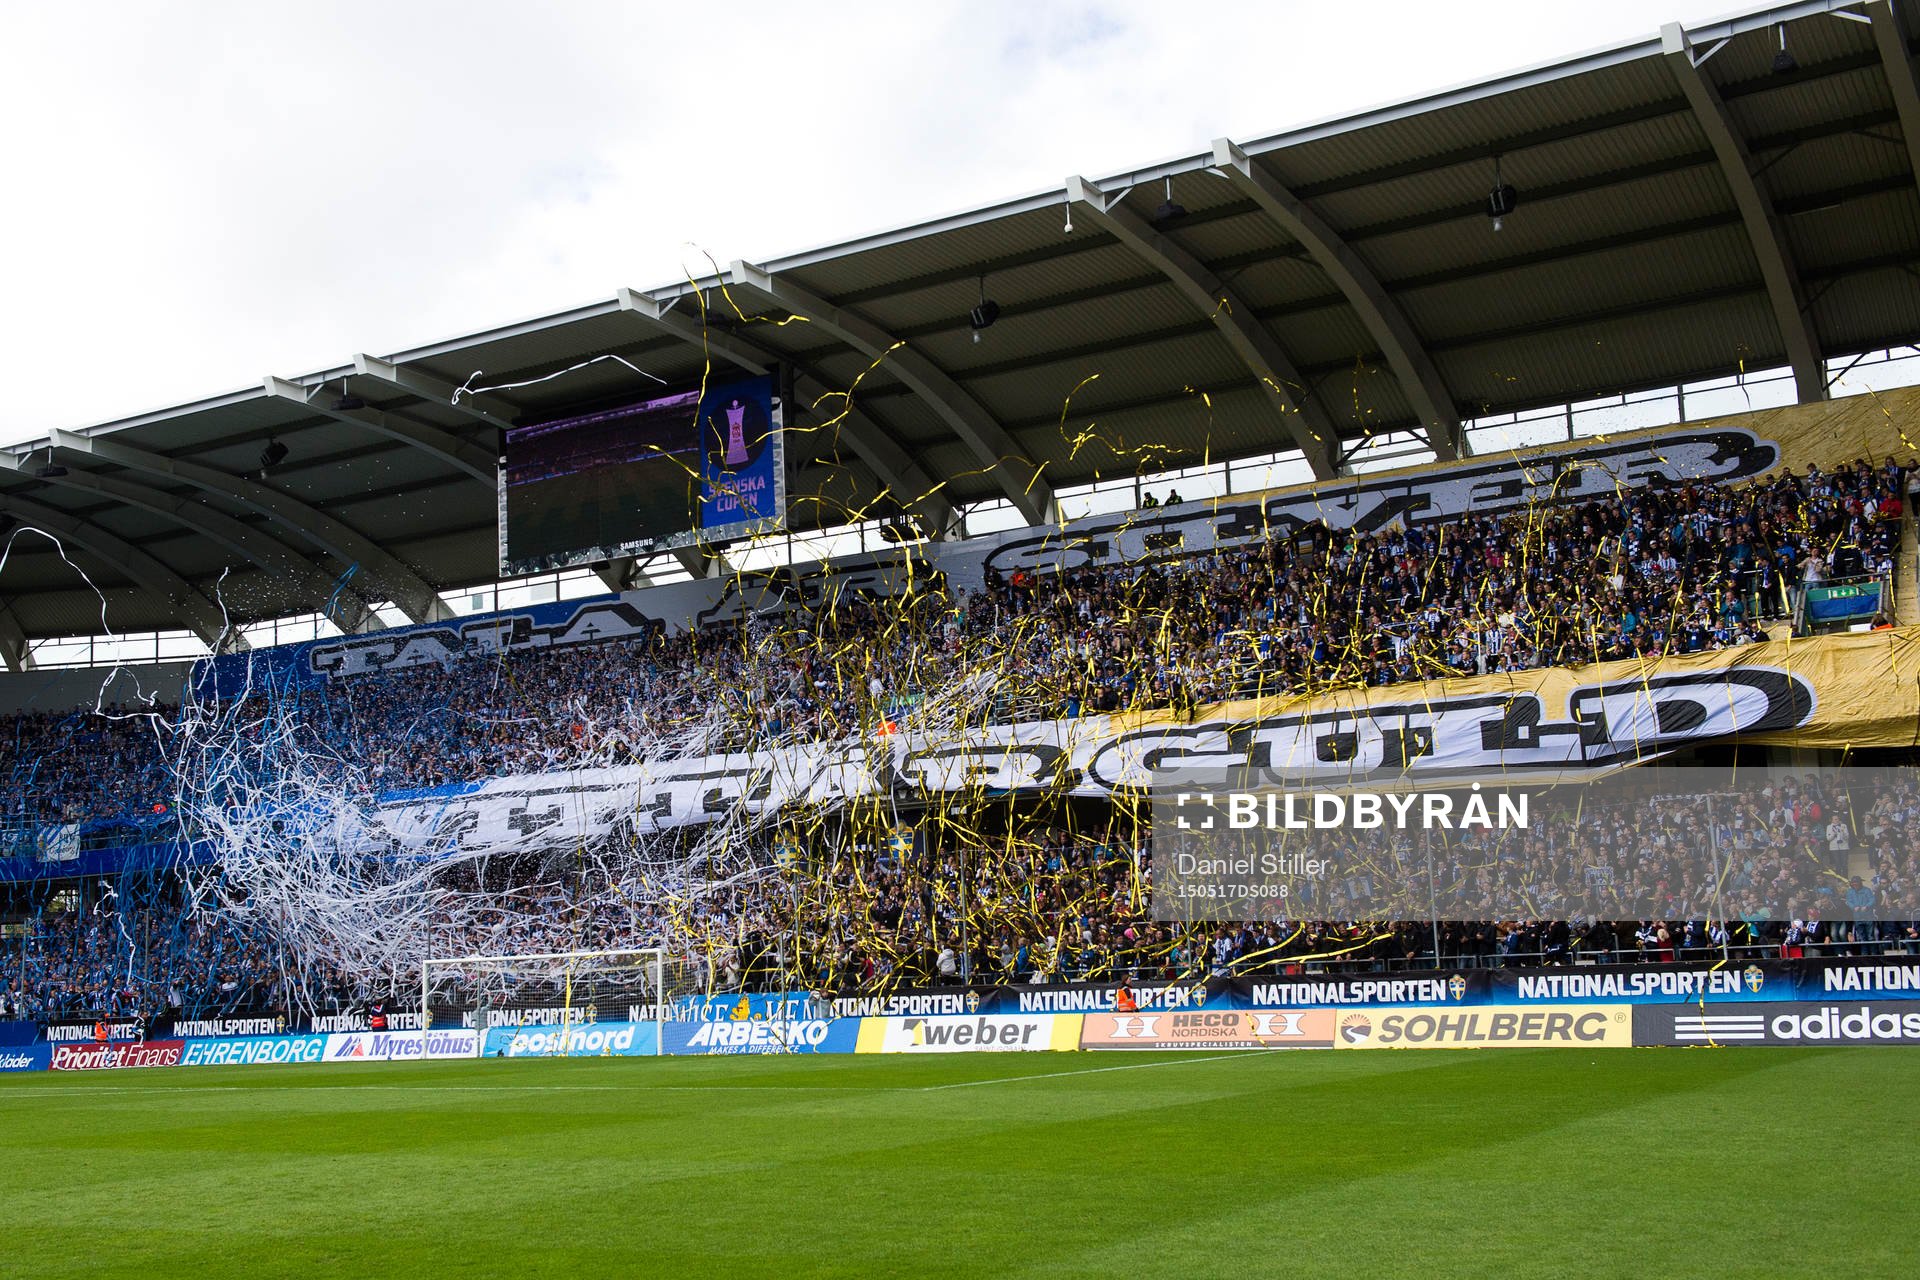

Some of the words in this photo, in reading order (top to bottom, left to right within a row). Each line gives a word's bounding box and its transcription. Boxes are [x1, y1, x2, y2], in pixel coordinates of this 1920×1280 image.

[716, 491, 758, 513] CUPEN
[620, 538, 654, 551] SAMSUNG
[1088, 667, 1814, 796] GULD
[1252, 979, 1447, 1006] NATIONALSPORTEN
[1518, 970, 1741, 998] NATIONALSPORTEN
[173, 1017, 276, 1037] NATIONALSPORTEN
[687, 1021, 829, 1046] ARBESKO
[924, 1017, 1038, 1046] weber
[1171, 1027, 1238, 1038] NORDISKA
[1172, 1013, 1240, 1028] HECO
[1378, 1012, 1610, 1043] SOHLBERG
[1771, 1007, 1920, 1040] adidas
[52, 1047, 127, 1069] Prioritet
[126, 1045, 179, 1067] Finans
[183, 1039, 322, 1066] EHRENBORG
